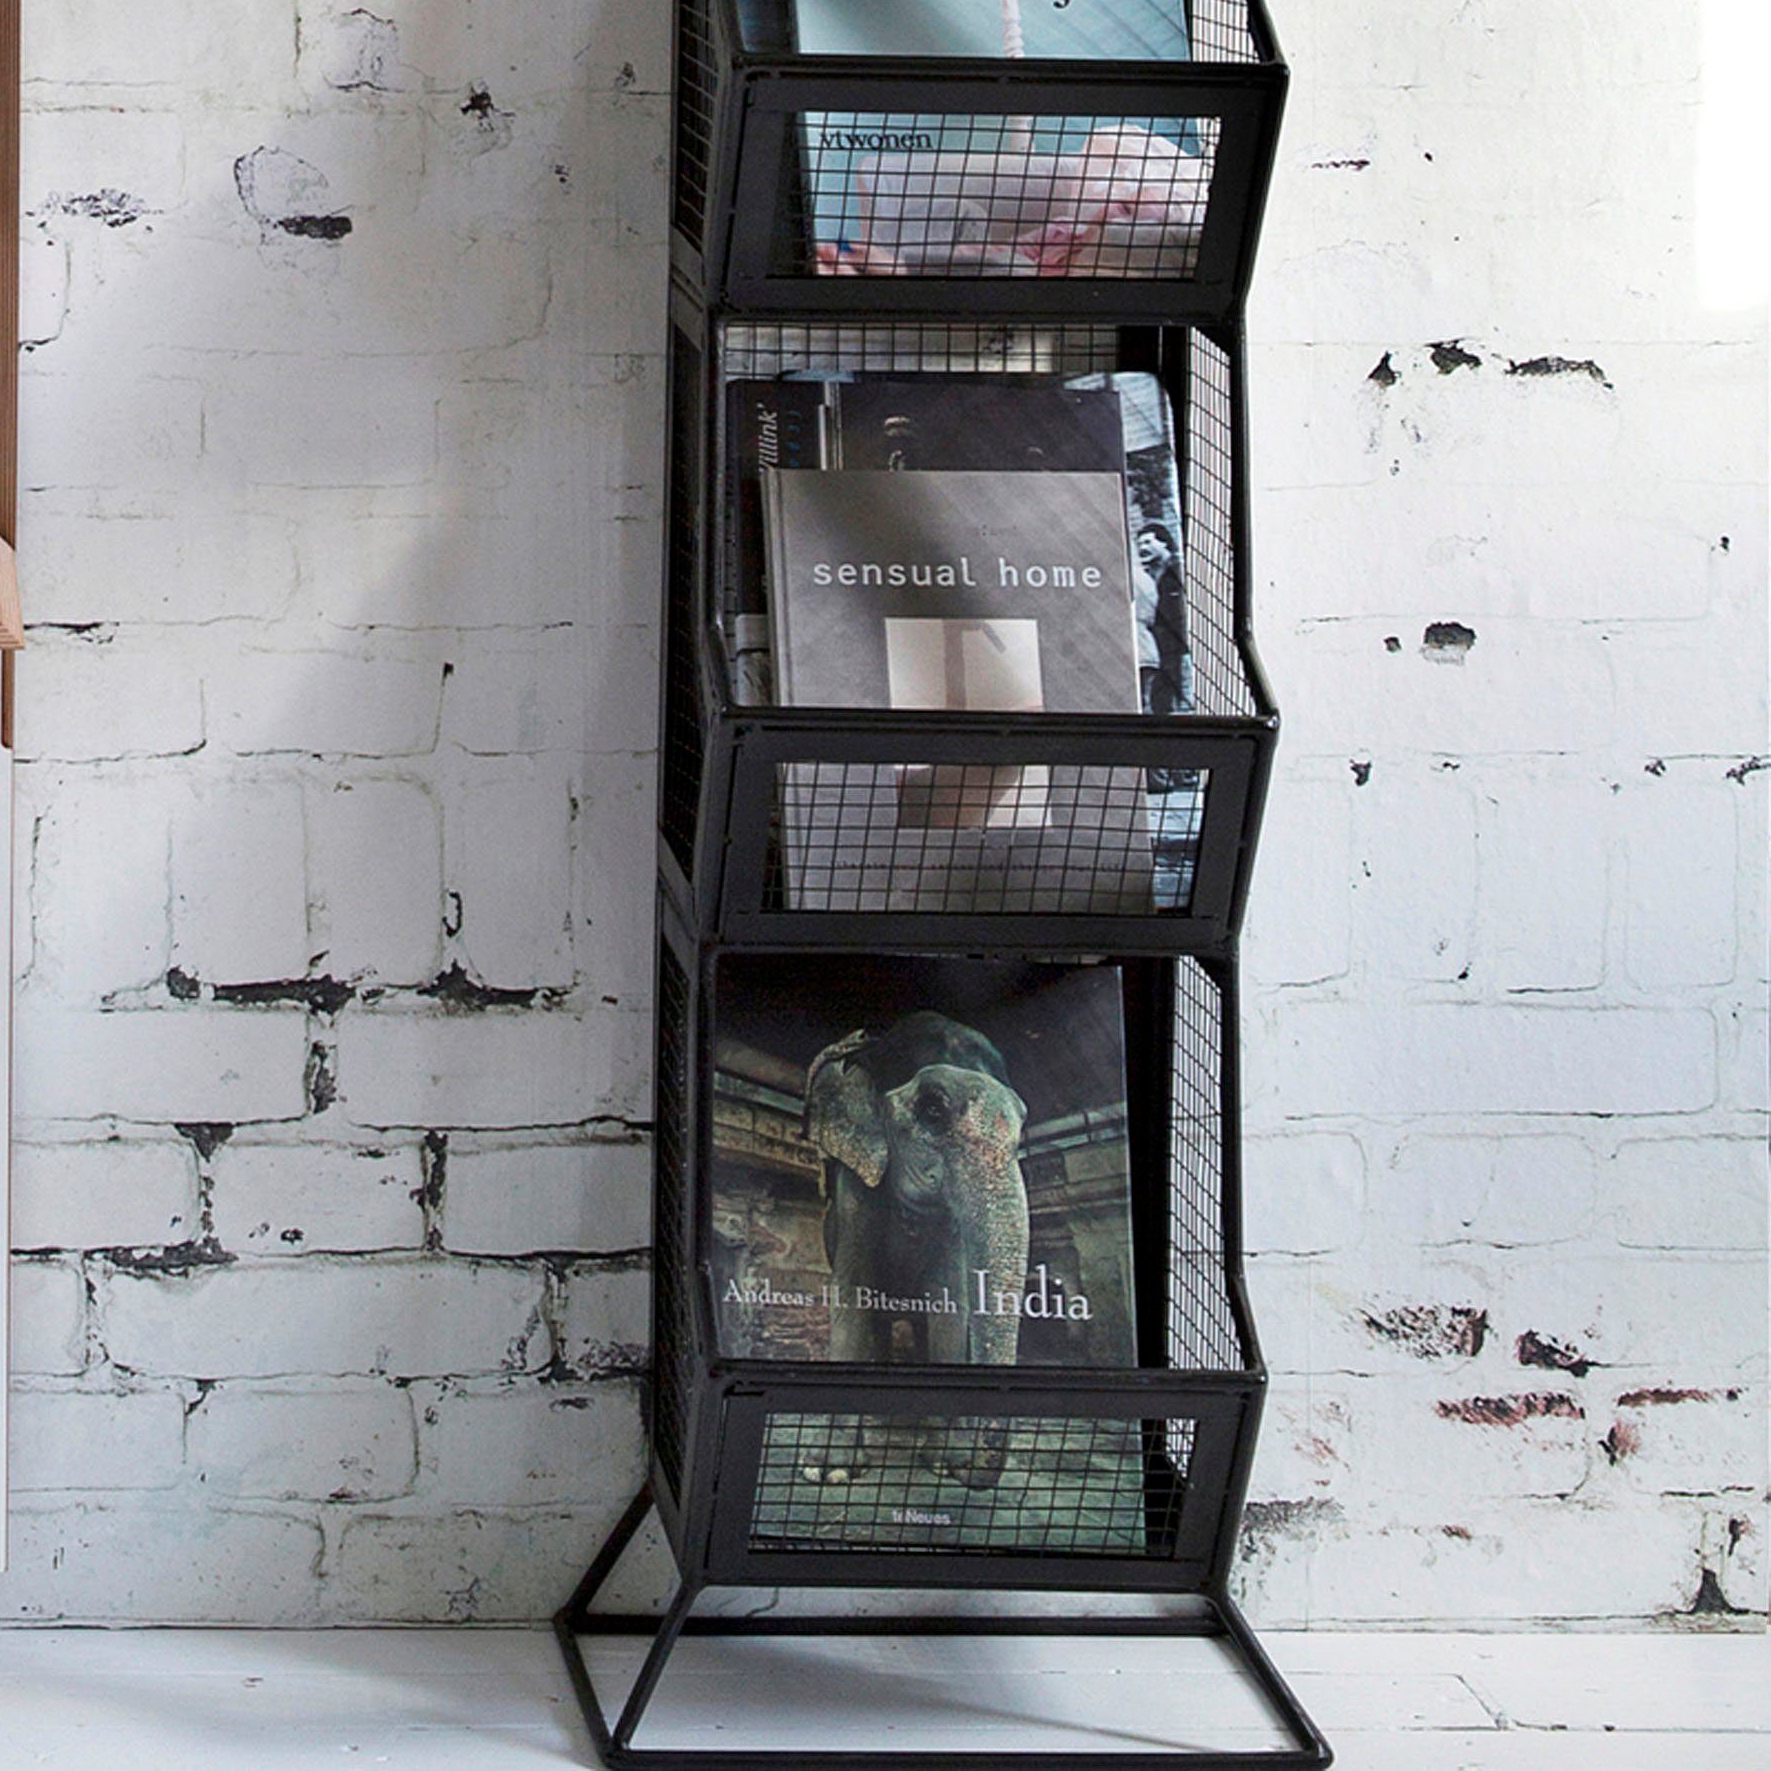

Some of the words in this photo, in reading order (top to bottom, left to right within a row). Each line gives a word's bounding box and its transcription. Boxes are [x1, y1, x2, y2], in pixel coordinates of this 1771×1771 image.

[813, 557, 977, 587] sensual
[998, 558, 1102, 588] home
[723, 1278, 815, 1307] Andreas
[821, 1286, 848, 1308] H.
[855, 1285, 958, 1315] Bitesnich
[972, 1264, 1092, 1321] India
